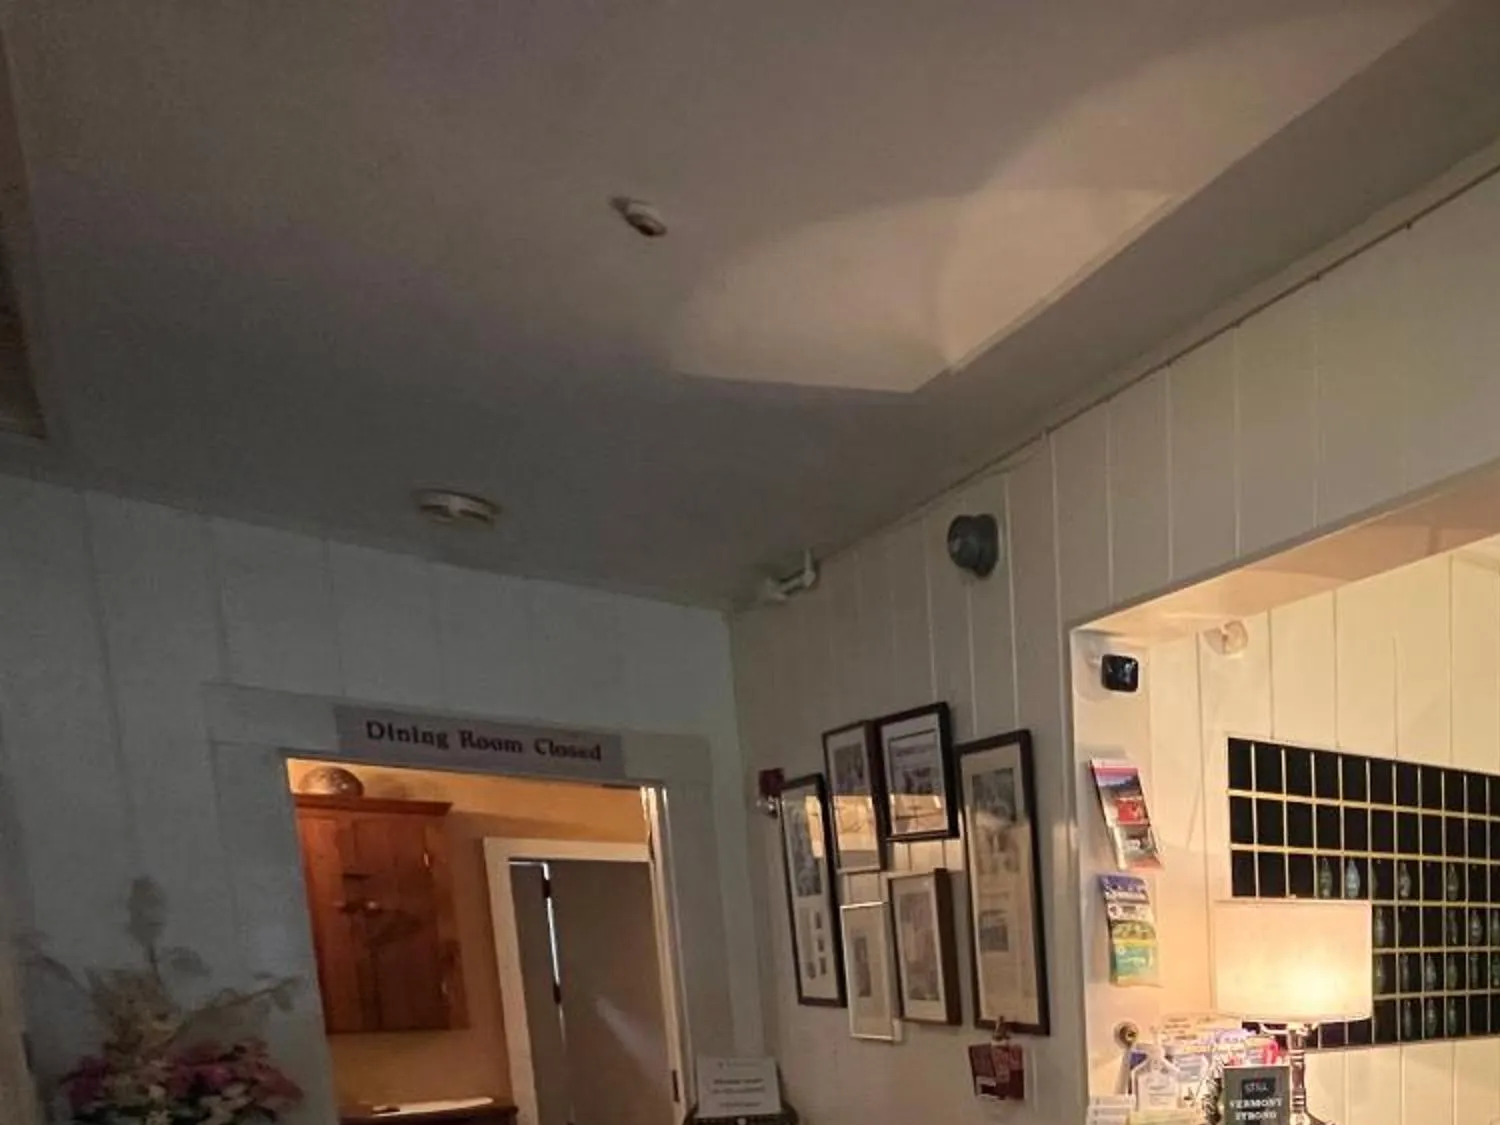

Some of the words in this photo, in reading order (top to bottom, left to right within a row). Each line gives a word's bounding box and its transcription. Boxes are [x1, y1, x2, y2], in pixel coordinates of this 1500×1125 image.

[366, 720, 449, 749] Dining
[457, 729, 523, 753] Room
[533, 738, 602, 761] Closed
[1229, 1097, 1283, 1109] VERMONT
